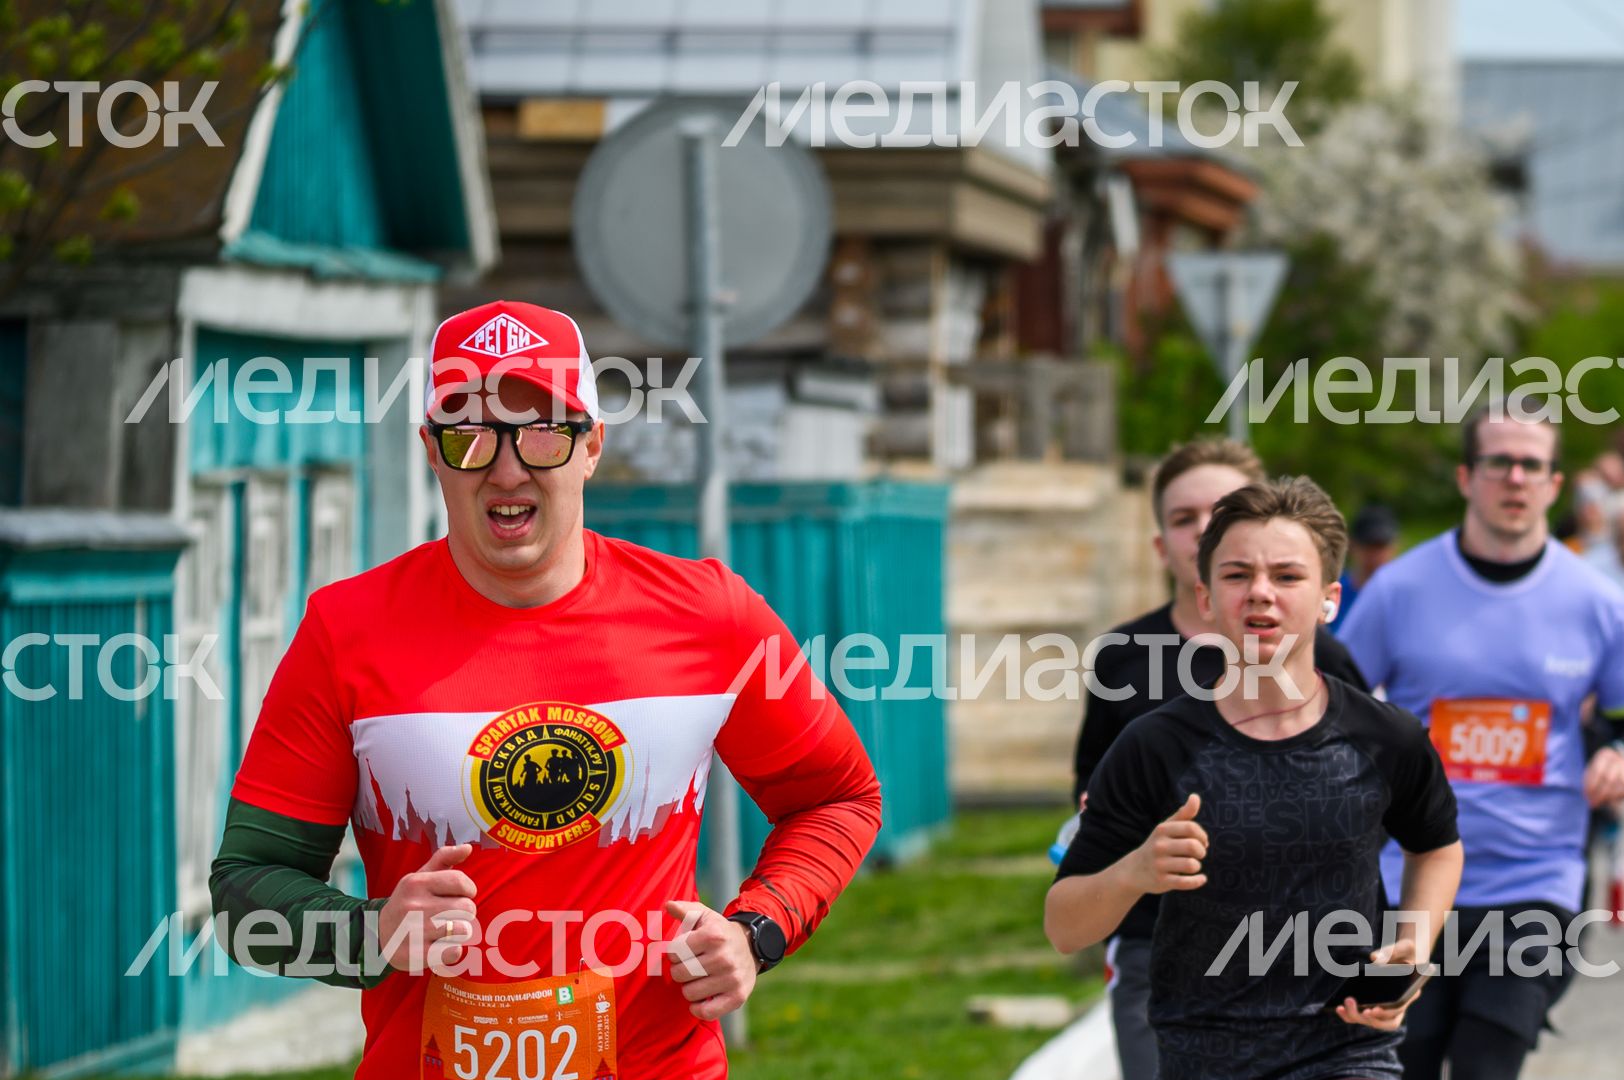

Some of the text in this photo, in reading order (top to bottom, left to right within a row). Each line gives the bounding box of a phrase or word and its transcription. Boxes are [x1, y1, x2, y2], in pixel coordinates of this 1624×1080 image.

[474, 317, 531, 355] РЕГБИ
[475, 706, 620, 756] SPARTAK MOSCOW
[493, 729, 538, 770] СКВАД
[1449, 722, 1528, 766] 5009
[556, 782, 601, 825] SQUAD
[497, 820, 593, 850] SUPPORTERS
